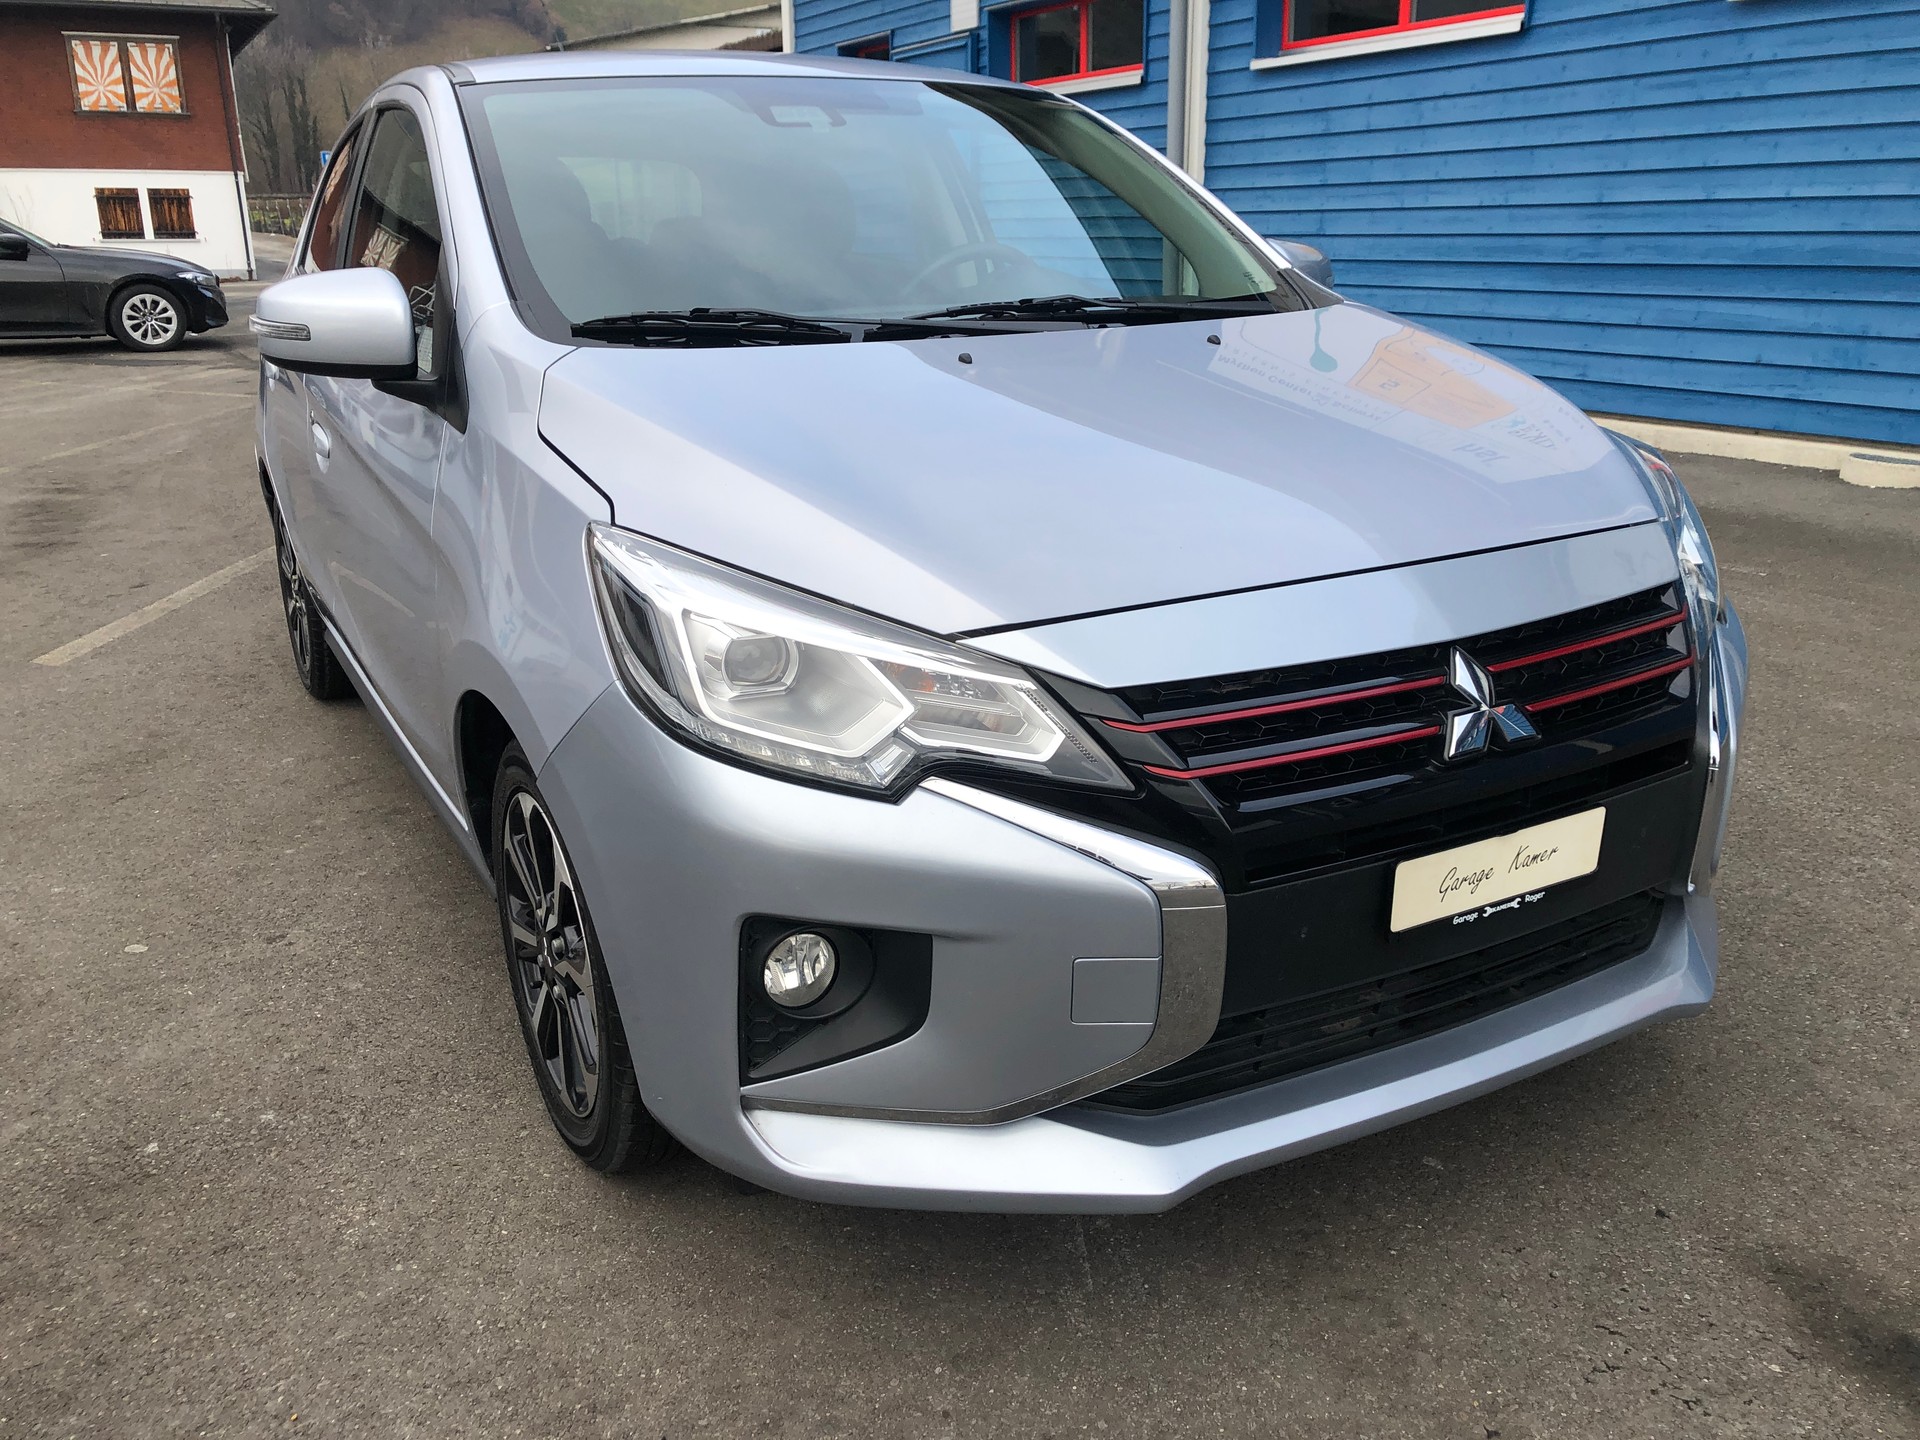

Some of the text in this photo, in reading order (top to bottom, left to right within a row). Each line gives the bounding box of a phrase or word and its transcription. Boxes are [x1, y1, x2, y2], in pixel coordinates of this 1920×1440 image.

[1438, 845, 1559, 903] Garage Kamer
[1452, 912, 1479, 925] Garage
[1524, 891, 1546, 902] Roger
